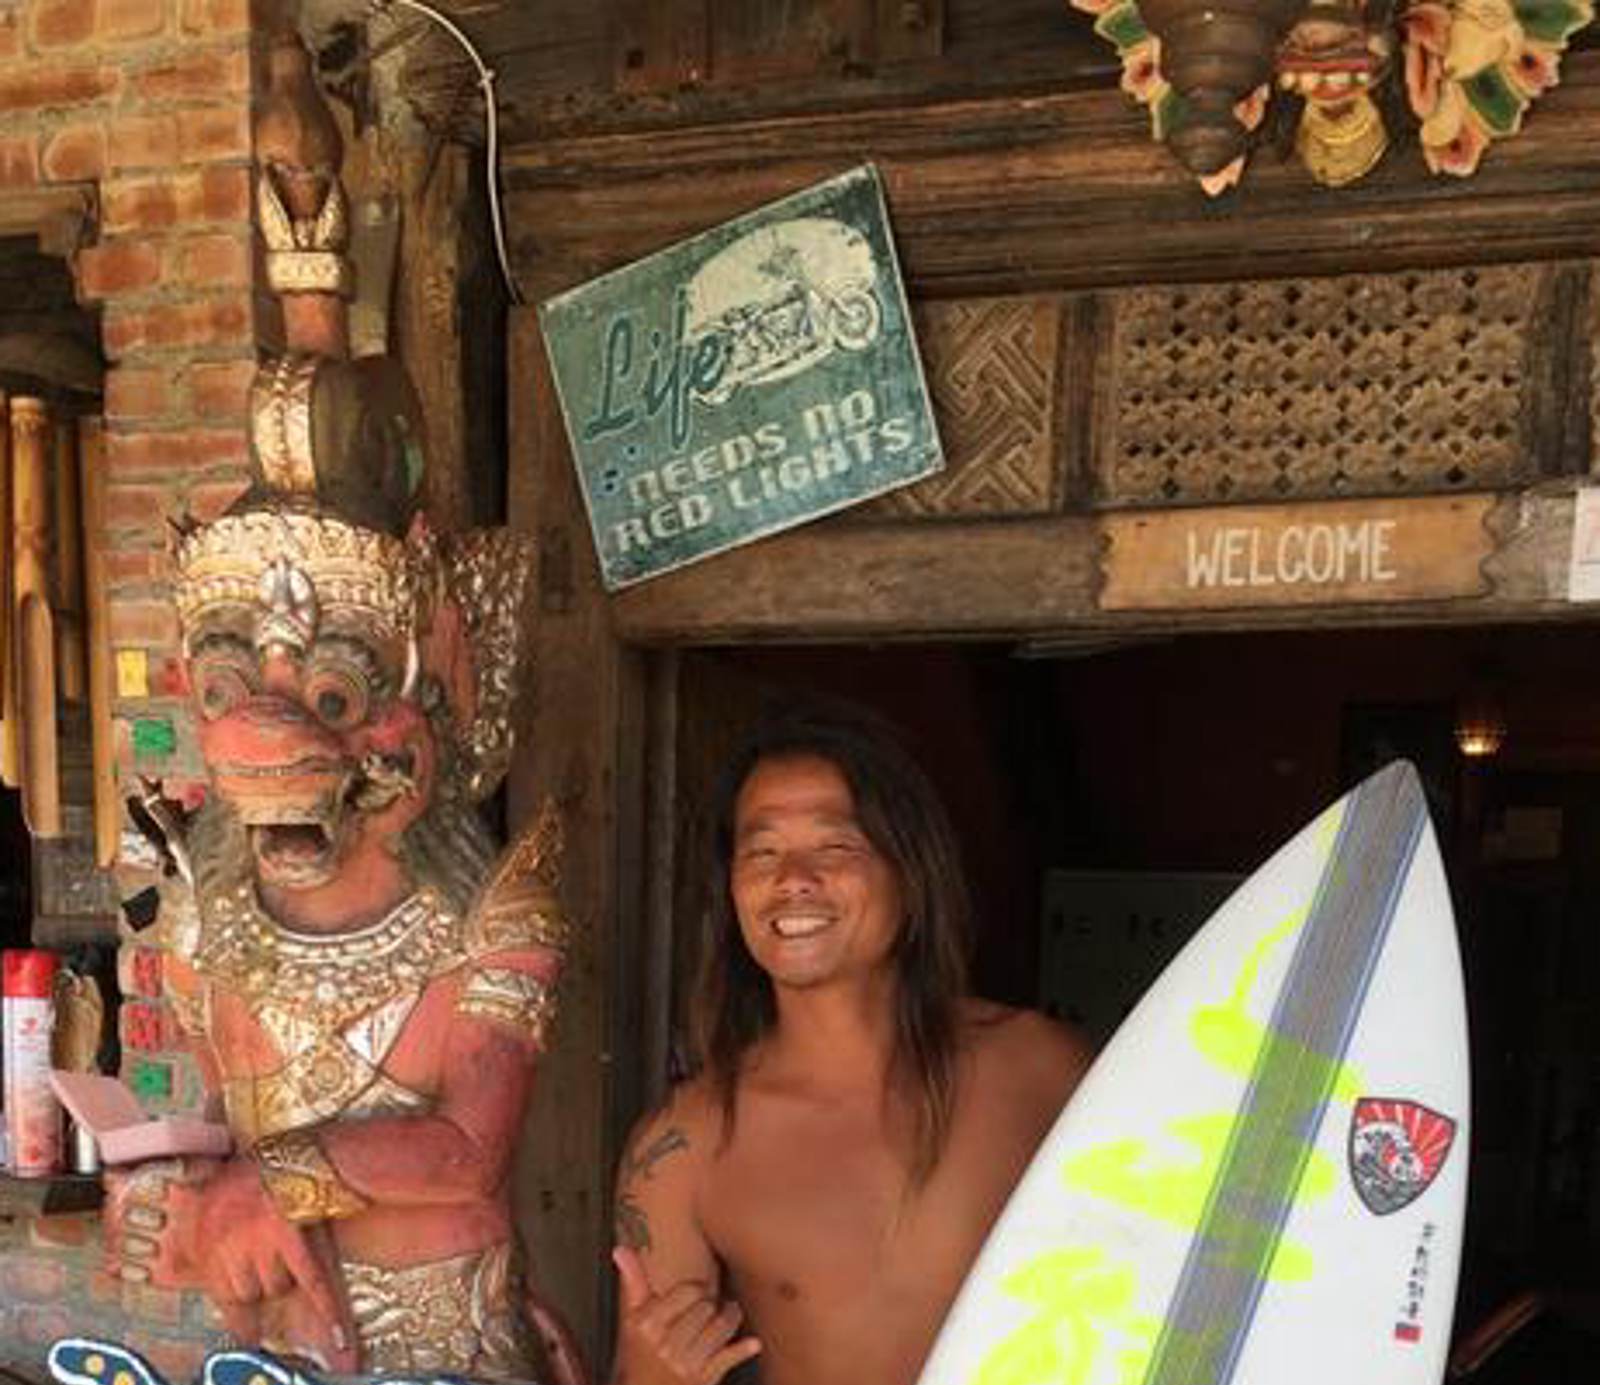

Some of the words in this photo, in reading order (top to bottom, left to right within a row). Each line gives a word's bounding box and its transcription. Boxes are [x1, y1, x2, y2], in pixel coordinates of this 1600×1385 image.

[584, 284, 729, 451] Life
[612, 493, 716, 553] RED
[728, 416, 915, 510] LIGHTS
[1184, 519, 1398, 588] WELCOME
